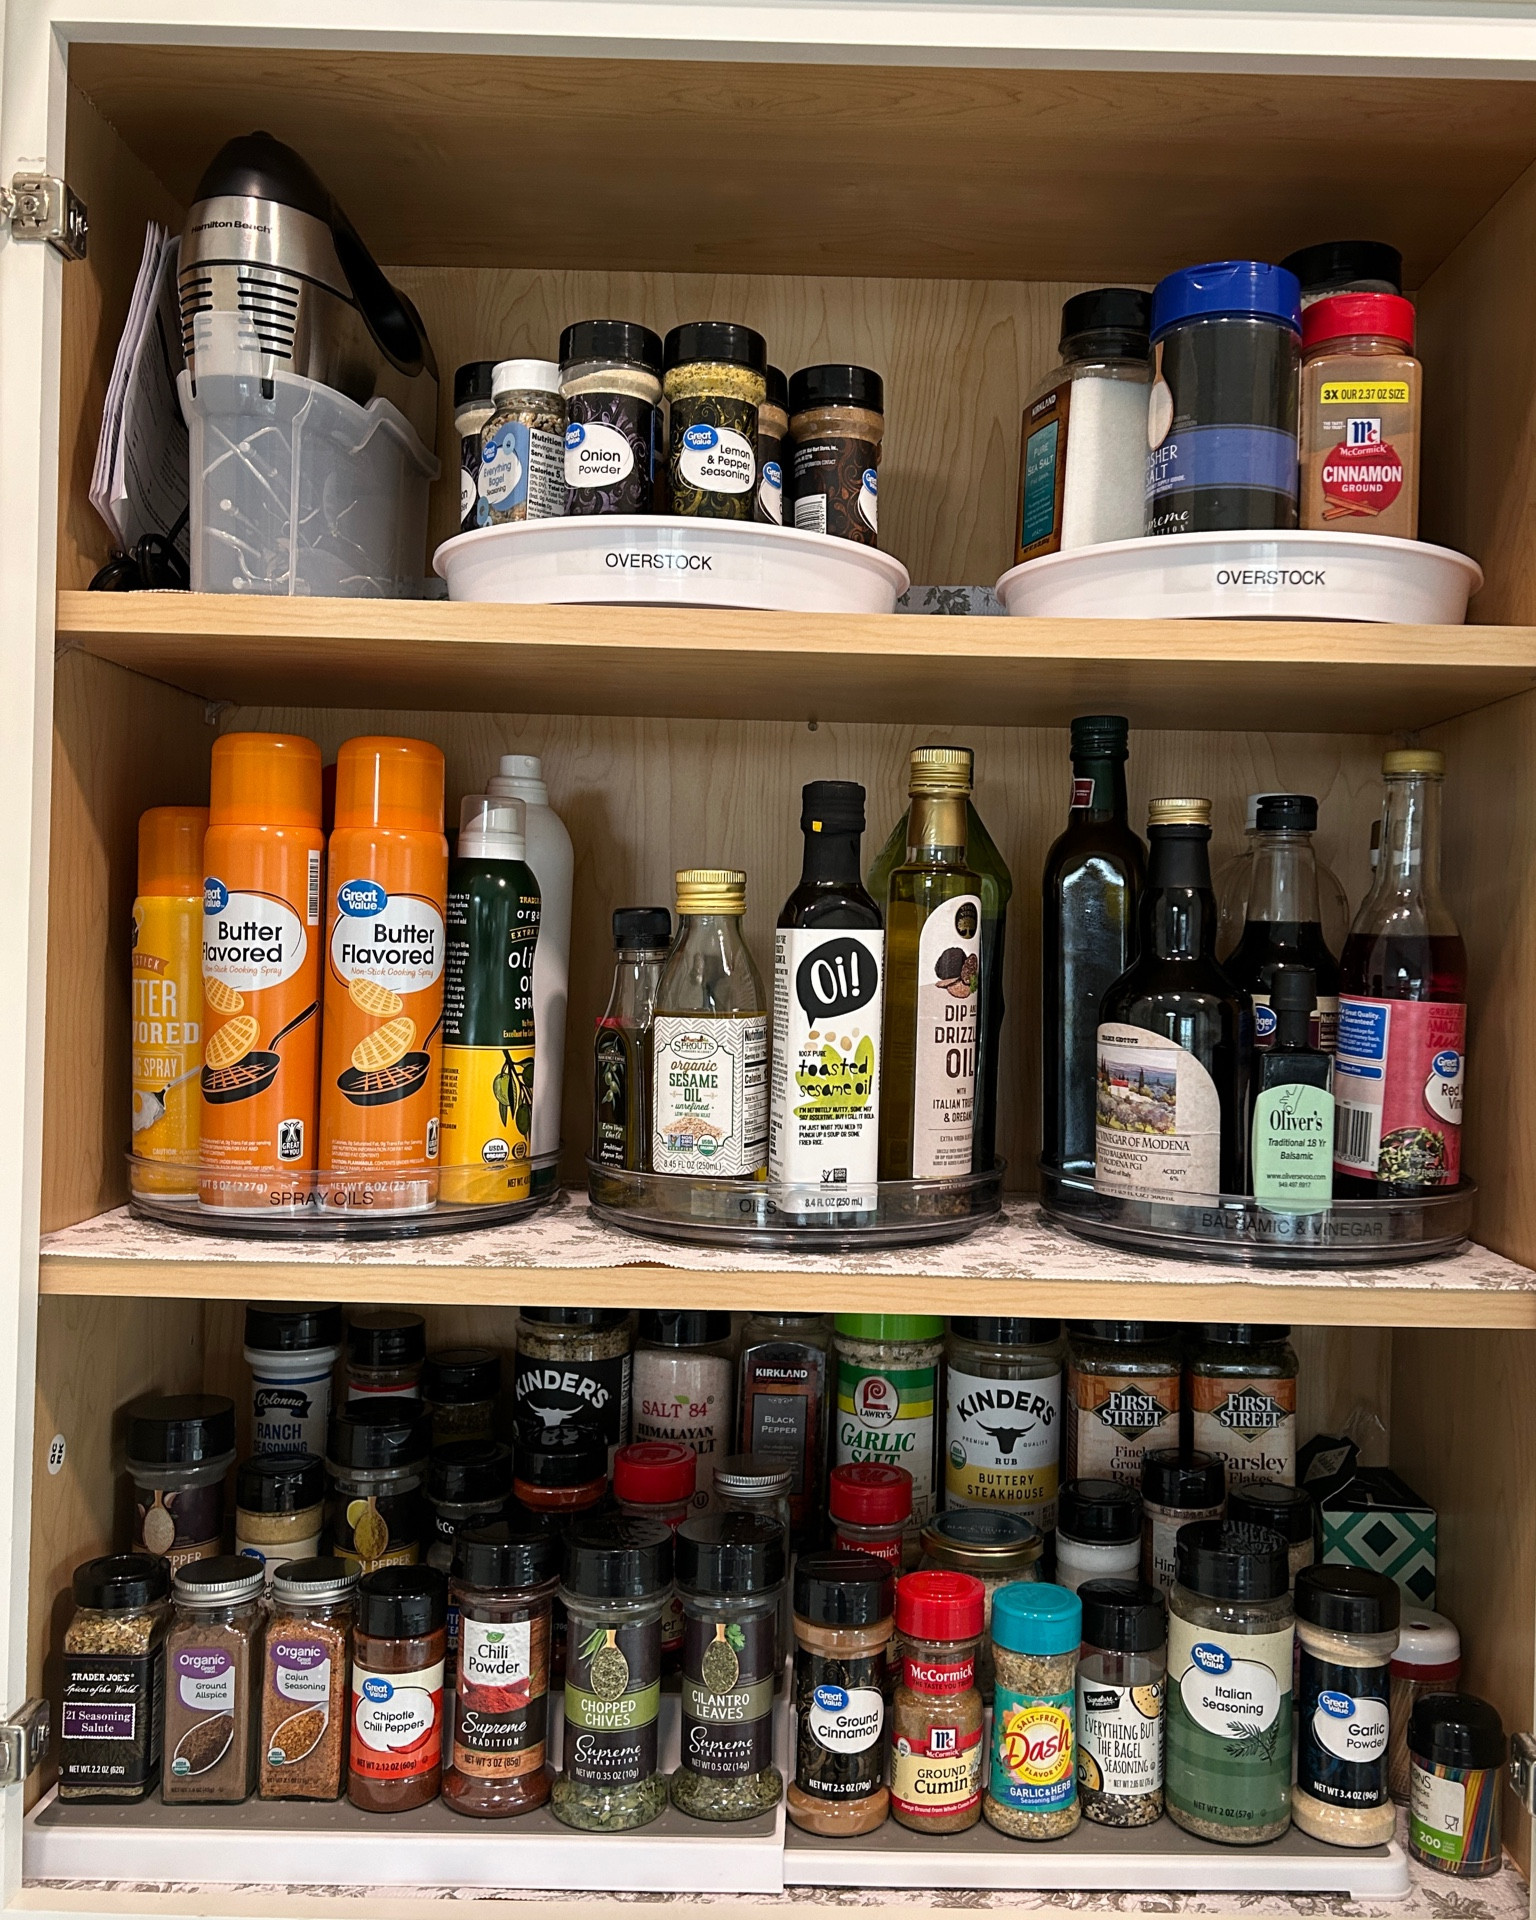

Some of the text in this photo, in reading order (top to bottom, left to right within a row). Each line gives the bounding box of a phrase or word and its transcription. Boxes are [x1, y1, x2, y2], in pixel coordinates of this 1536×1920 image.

[192, 220, 232, 234] Hamilton
[1324, 388, 1405, 400] 3X OUR 2.37 OZ SIZE
[1032, 394, 1056, 416] KIRKLAND
[532, 432, 562, 446] Nutrition
[687, 432, 712, 442] Great
[580, 449, 621, 462] Onion
[720, 444, 750, 459] Lemon
[1034, 443, 1048, 458] PURE
[1340, 445, 1387, 456] McCormick
[484, 462, 512, 478] Everything
[578, 463, 622, 475] Powder
[707, 456, 750, 472] & Pepper
[489, 474, 504, 486] Bagel
[700, 466, 750, 484] Seasoning
[1323, 466, 1402, 482] CINNAMON
[486, 485, 507, 496] Seasoning
[1342, 484, 1383, 492] GROUND
[605, 553, 712, 570] OVERSTOCK
[1216, 570, 1326, 585] OVERSTOCK
[342, 888, 378, 902] Great
[349, 900, 378, 910] Value
[218, 921, 282, 942] Butter
[374, 924, 434, 944] Butter
[511, 929, 535, 940] EXTRA
[203, 942, 282, 962] Flavored
[342, 944, 434, 964] Flavored
[351, 966, 434, 978] Non-Stick Cooking Spray
[810, 952, 860, 1004] Oi!
[945, 1004, 967, 1022] DIP
[674, 1041, 714, 1052] SPROUTS
[144, 1058, 177, 1078] SPRAY
[670, 1060, 717, 1077] organic
[799, 1058, 868, 1077] toasted
[946, 1048, 974, 1078] OIL
[1437, 1057, 1458, 1067] Great
[669, 1073, 718, 1088] SESAME
[800, 1076, 872, 1097] sesame oil
[684, 1088, 702, 1102] OIL
[1441, 1083, 1460, 1097] Red
[1270, 1110, 1322, 1132] Oliver's
[282, 1141, 300, 1150] GREAT
[1099, 1132, 1190, 1152] VINEGAR OF MODENA
[1268, 1137, 1326, 1148] Traditional 18 Yr
[1280, 1151, 1313, 1160] Balsamic
[664, 1160, 722, 1171] 8.45 FL OZ (250mL)
[1162, 1168, 1187, 1176] ACIDITY
[270, 1190, 374, 1206] SPRAY OILS
[805, 1199, 816, 1208] 8.4
[818, 1199, 826, 1207] FL
[826, 1198, 836, 1207] OZ
[755, 1368, 808, 1378] KIRKLAND
[516, 1370, 609, 1408] KINDER'S
[642, 1400, 709, 1418] SALT 84
[956, 1389, 1057, 1426] KINDER'S
[1110, 1392, 1156, 1412] FIRST
[1228, 1393, 1275, 1412] FIRST
[764, 1416, 795, 1424] BLACK
[860, 1410, 892, 1420] LAWRY'S
[1102, 1409, 1162, 1426] STREET
[1220, 1411, 1280, 1428] STREET
[257, 1423, 302, 1440] RANCH
[638, 1424, 714, 1440] HIMALAYAN
[761, 1426, 798, 1434] PEPPER
[840, 1422, 916, 1452] GARLIC
[994, 1458, 1018, 1466] RUB
[978, 1473, 1034, 1486] BUTTERY
[967, 1485, 1044, 1500] STEAKHOUSE
[276, 1645, 321, 1660] Organic
[478, 1644, 508, 1659] Chili
[1194, 1648, 1224, 1664] Great
[180, 1654, 226, 1668] Organic
[469, 1656, 520, 1674] Powder
[1202, 1659, 1224, 1670] Value
[72, 1673, 130, 1682] TRADER JOE'S
[285, 1674, 308, 1682] Cajun
[911, 1664, 972, 1682] McCormick
[196, 1682, 227, 1690] Ground
[284, 1682, 326, 1692] Seasoning
[364, 1681, 388, 1693] Great
[1216, 1686, 1252, 1700] Italian
[195, 1691, 228, 1700] Allspice
[370, 1690, 388, 1699] Value
[692, 1690, 750, 1707] CILANTRO
[818, 1690, 842, 1702] Great
[1322, 1695, 1349, 1708] Great
[581, 1698, 636, 1714] CHOPPED
[823, 1698, 842, 1707] Value
[1202, 1697, 1264, 1716] Seasoning
[1328, 1704, 1349, 1714] Value
[66, 1710, 132, 1722] 21 Seasoning
[373, 1710, 414, 1722] Chipotle
[585, 1712, 631, 1727] CHIVES
[696, 1704, 744, 1720] LEAVES
[836, 1710, 878, 1728] Ground
[81, 1722, 114, 1733] Salute
[364, 1719, 424, 1734] Chili Peppers
[461, 1712, 527, 1738] Supreme
[1017, 1714, 1059, 1731] SALT-FREE
[1085, 1714, 1154, 1740] EVERYTHING BUT
[1348, 1722, 1384, 1736] Garlic
[818, 1724, 878, 1739] Cinnamon
[468, 1734, 519, 1747] TRADITION
[689, 1726, 754, 1753] Supreme
[1003, 1720, 1070, 1770] Dash
[574, 1734, 642, 1762] Supreme
[1098, 1737, 1142, 1758] THE BAGEL
[918, 1764, 966, 1779] GROUND
[1104, 1756, 1148, 1774] SEASONING
[914, 1776, 968, 1794] Cumin
[1314, 1780, 1378, 1801] NET WT 3.4 OZ (96g)
[1420, 1832, 1442, 1850] 200
